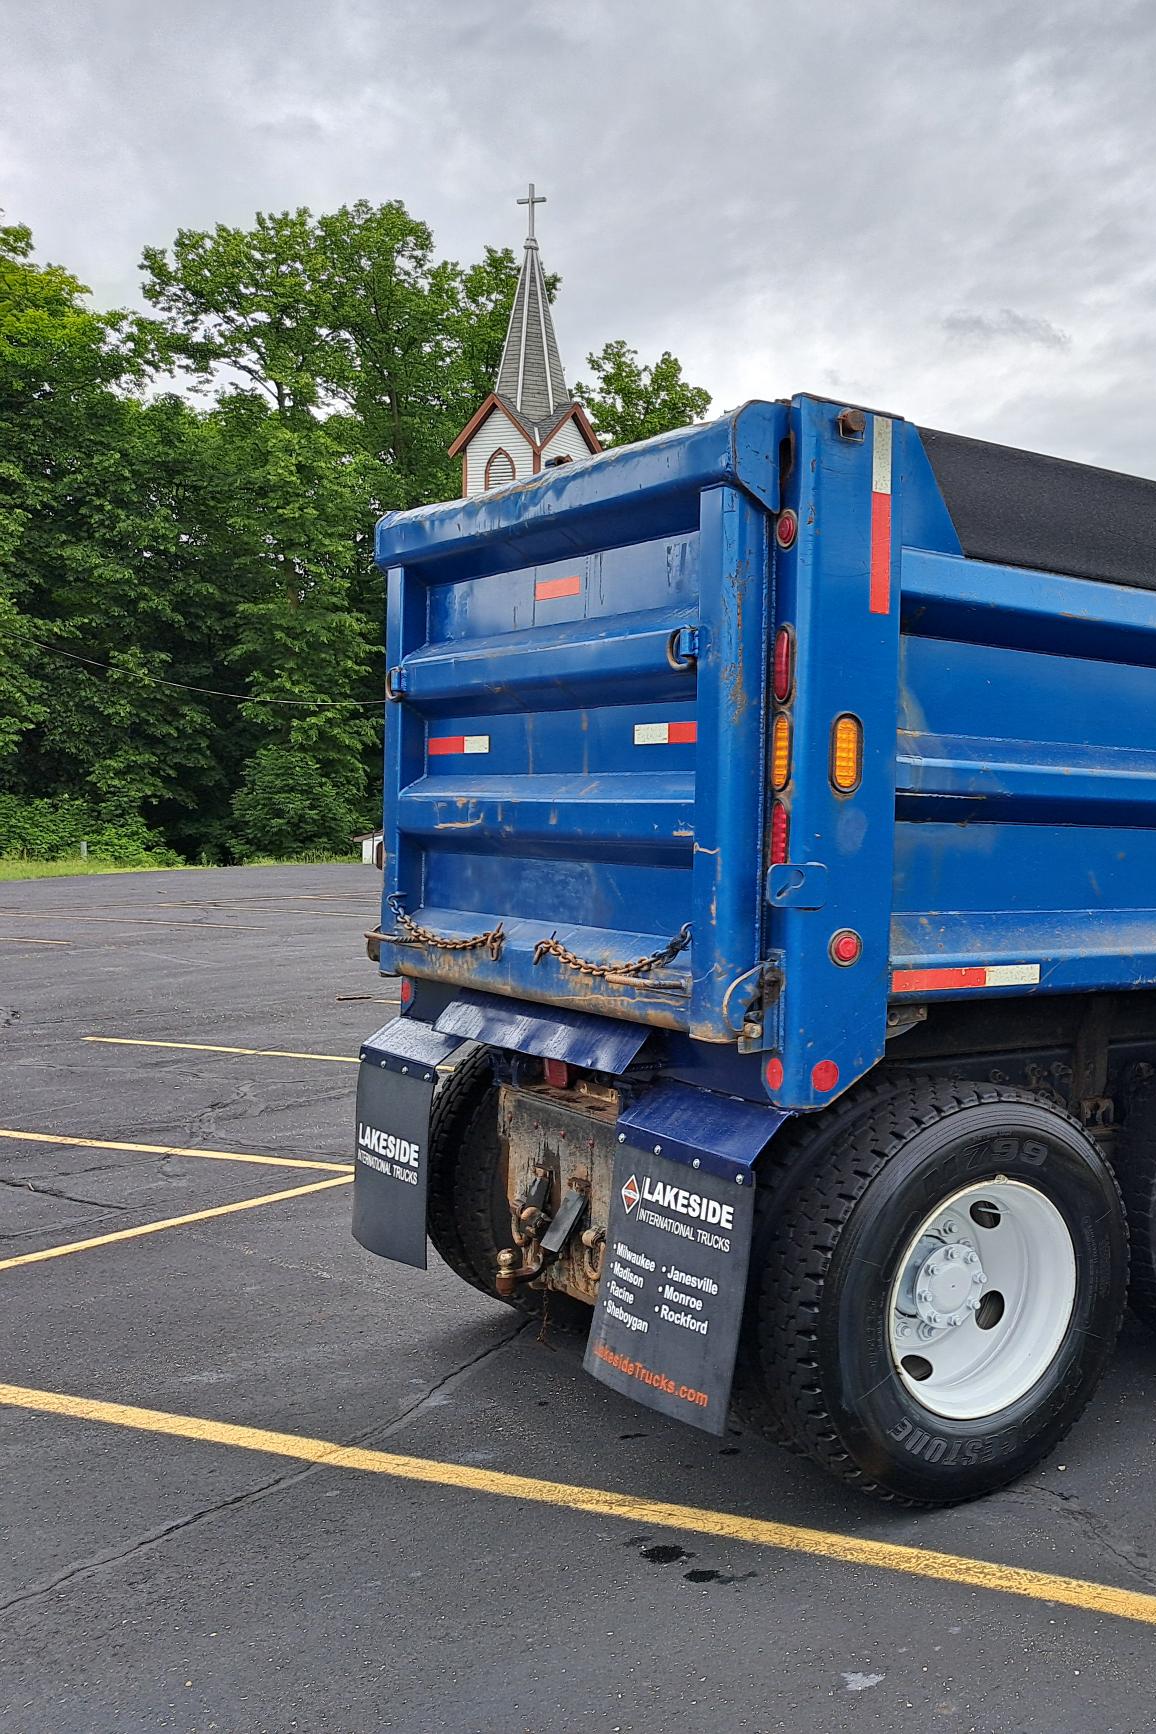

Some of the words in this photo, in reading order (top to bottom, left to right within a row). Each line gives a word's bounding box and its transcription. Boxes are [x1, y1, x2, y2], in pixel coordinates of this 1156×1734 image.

[358, 1122, 420, 1168] LAKESIDE
[357, 1148, 392, 1176] INTERNATIONAL
[392, 1164, 418, 1186] TRUCKS
[642, 1177, 735, 1230] LAKESIDE
[639, 1208, 695, 1241] INTERNATIONAL
[696, 1229, 731, 1253] TRUCKS
[616, 1242, 656, 1272] Milwaukee
[613, 1261, 644, 1288] Madison
[667, 1265, 719, 1296] Janesville
[609, 1280, 635, 1305] Racine
[663, 1284, 703, 1311] Monroe
[606, 1299, 649, 1333] Sheboygan
[660, 1304, 709, 1335] Rockford
[593, 1338, 709, 1407] LakesideTrucks.com
